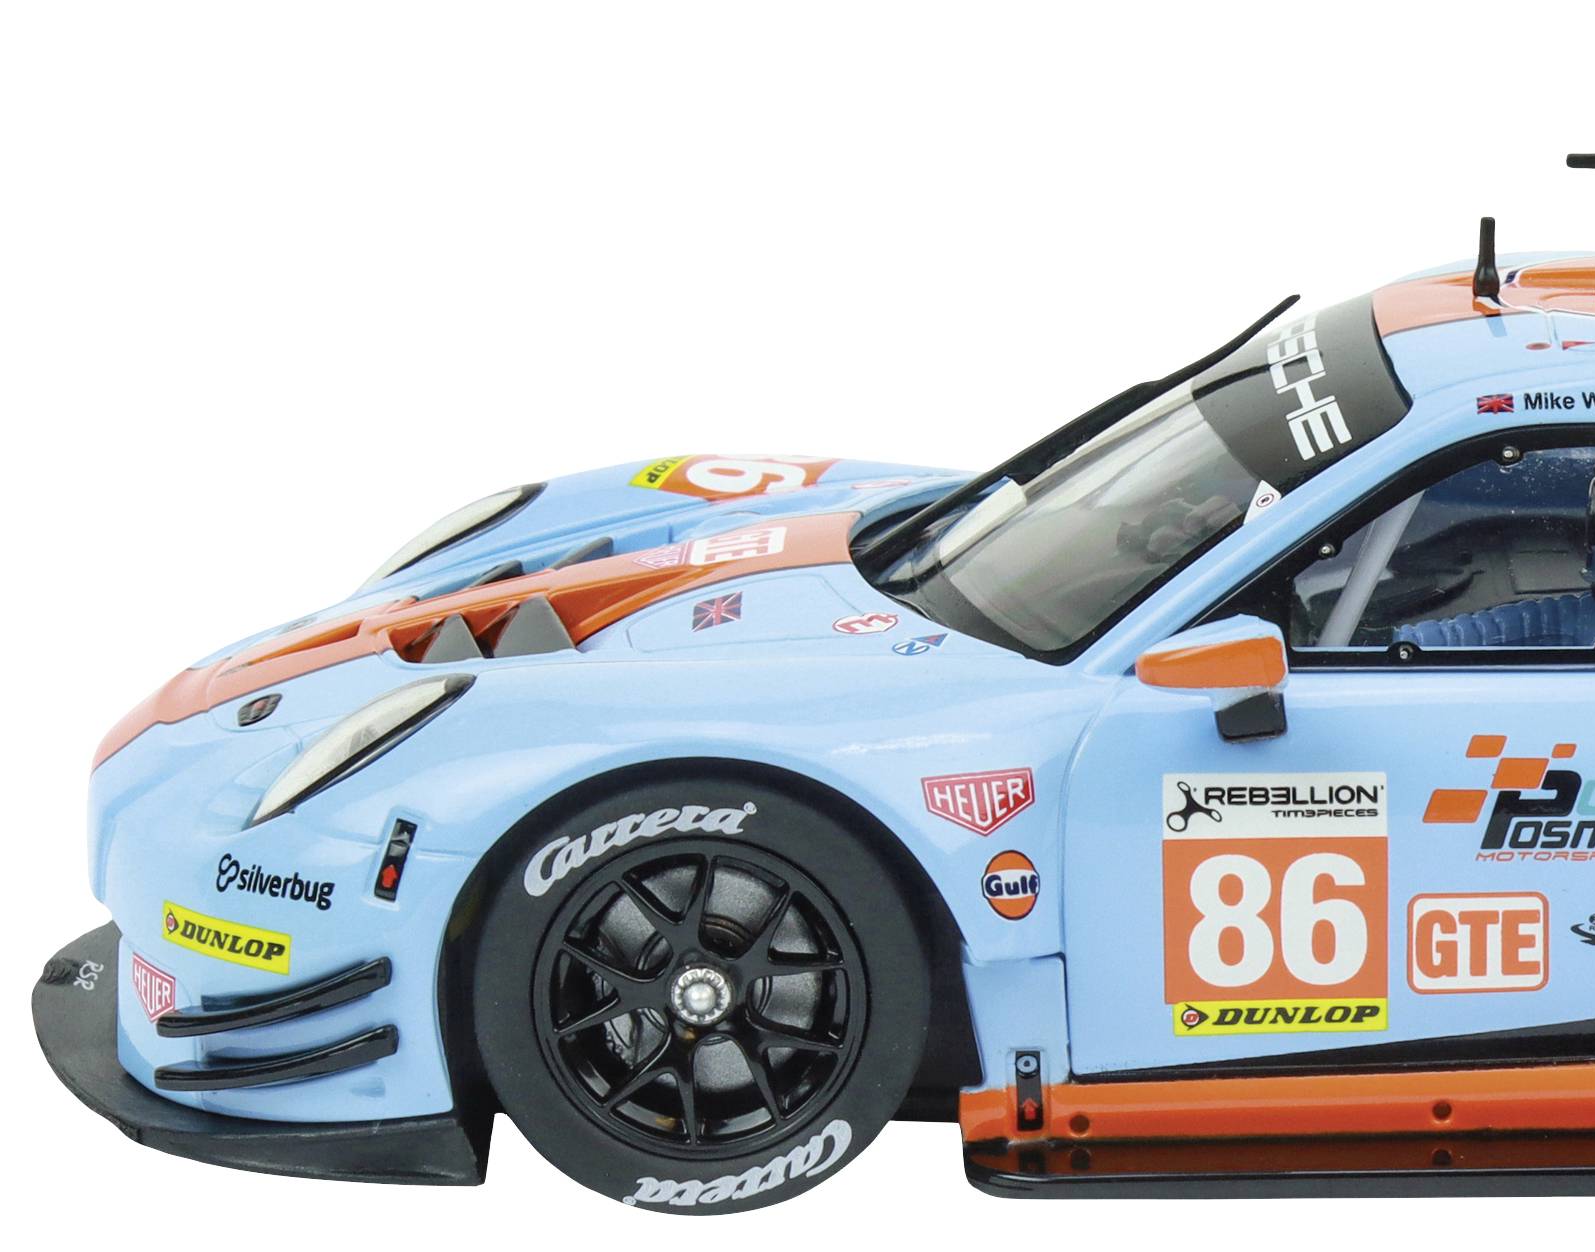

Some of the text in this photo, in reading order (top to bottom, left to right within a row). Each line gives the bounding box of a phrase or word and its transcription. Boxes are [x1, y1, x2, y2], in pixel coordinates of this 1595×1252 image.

[1524, 392, 1575, 411] Mike
[933, 777, 1026, 828] HEUER
[238, 864, 336, 911] silverbug
[984, 874, 1039, 897] Gulf
[180, 919, 286, 961] DUNLOP
[1187, 852, 1369, 988] 86
[1415, 909, 1541, 979] GTE
[73, 960, 105, 991] RSR
[134, 963, 171, 1015] HEUER
[1212, 1004, 1381, 1026] DUNLOP
